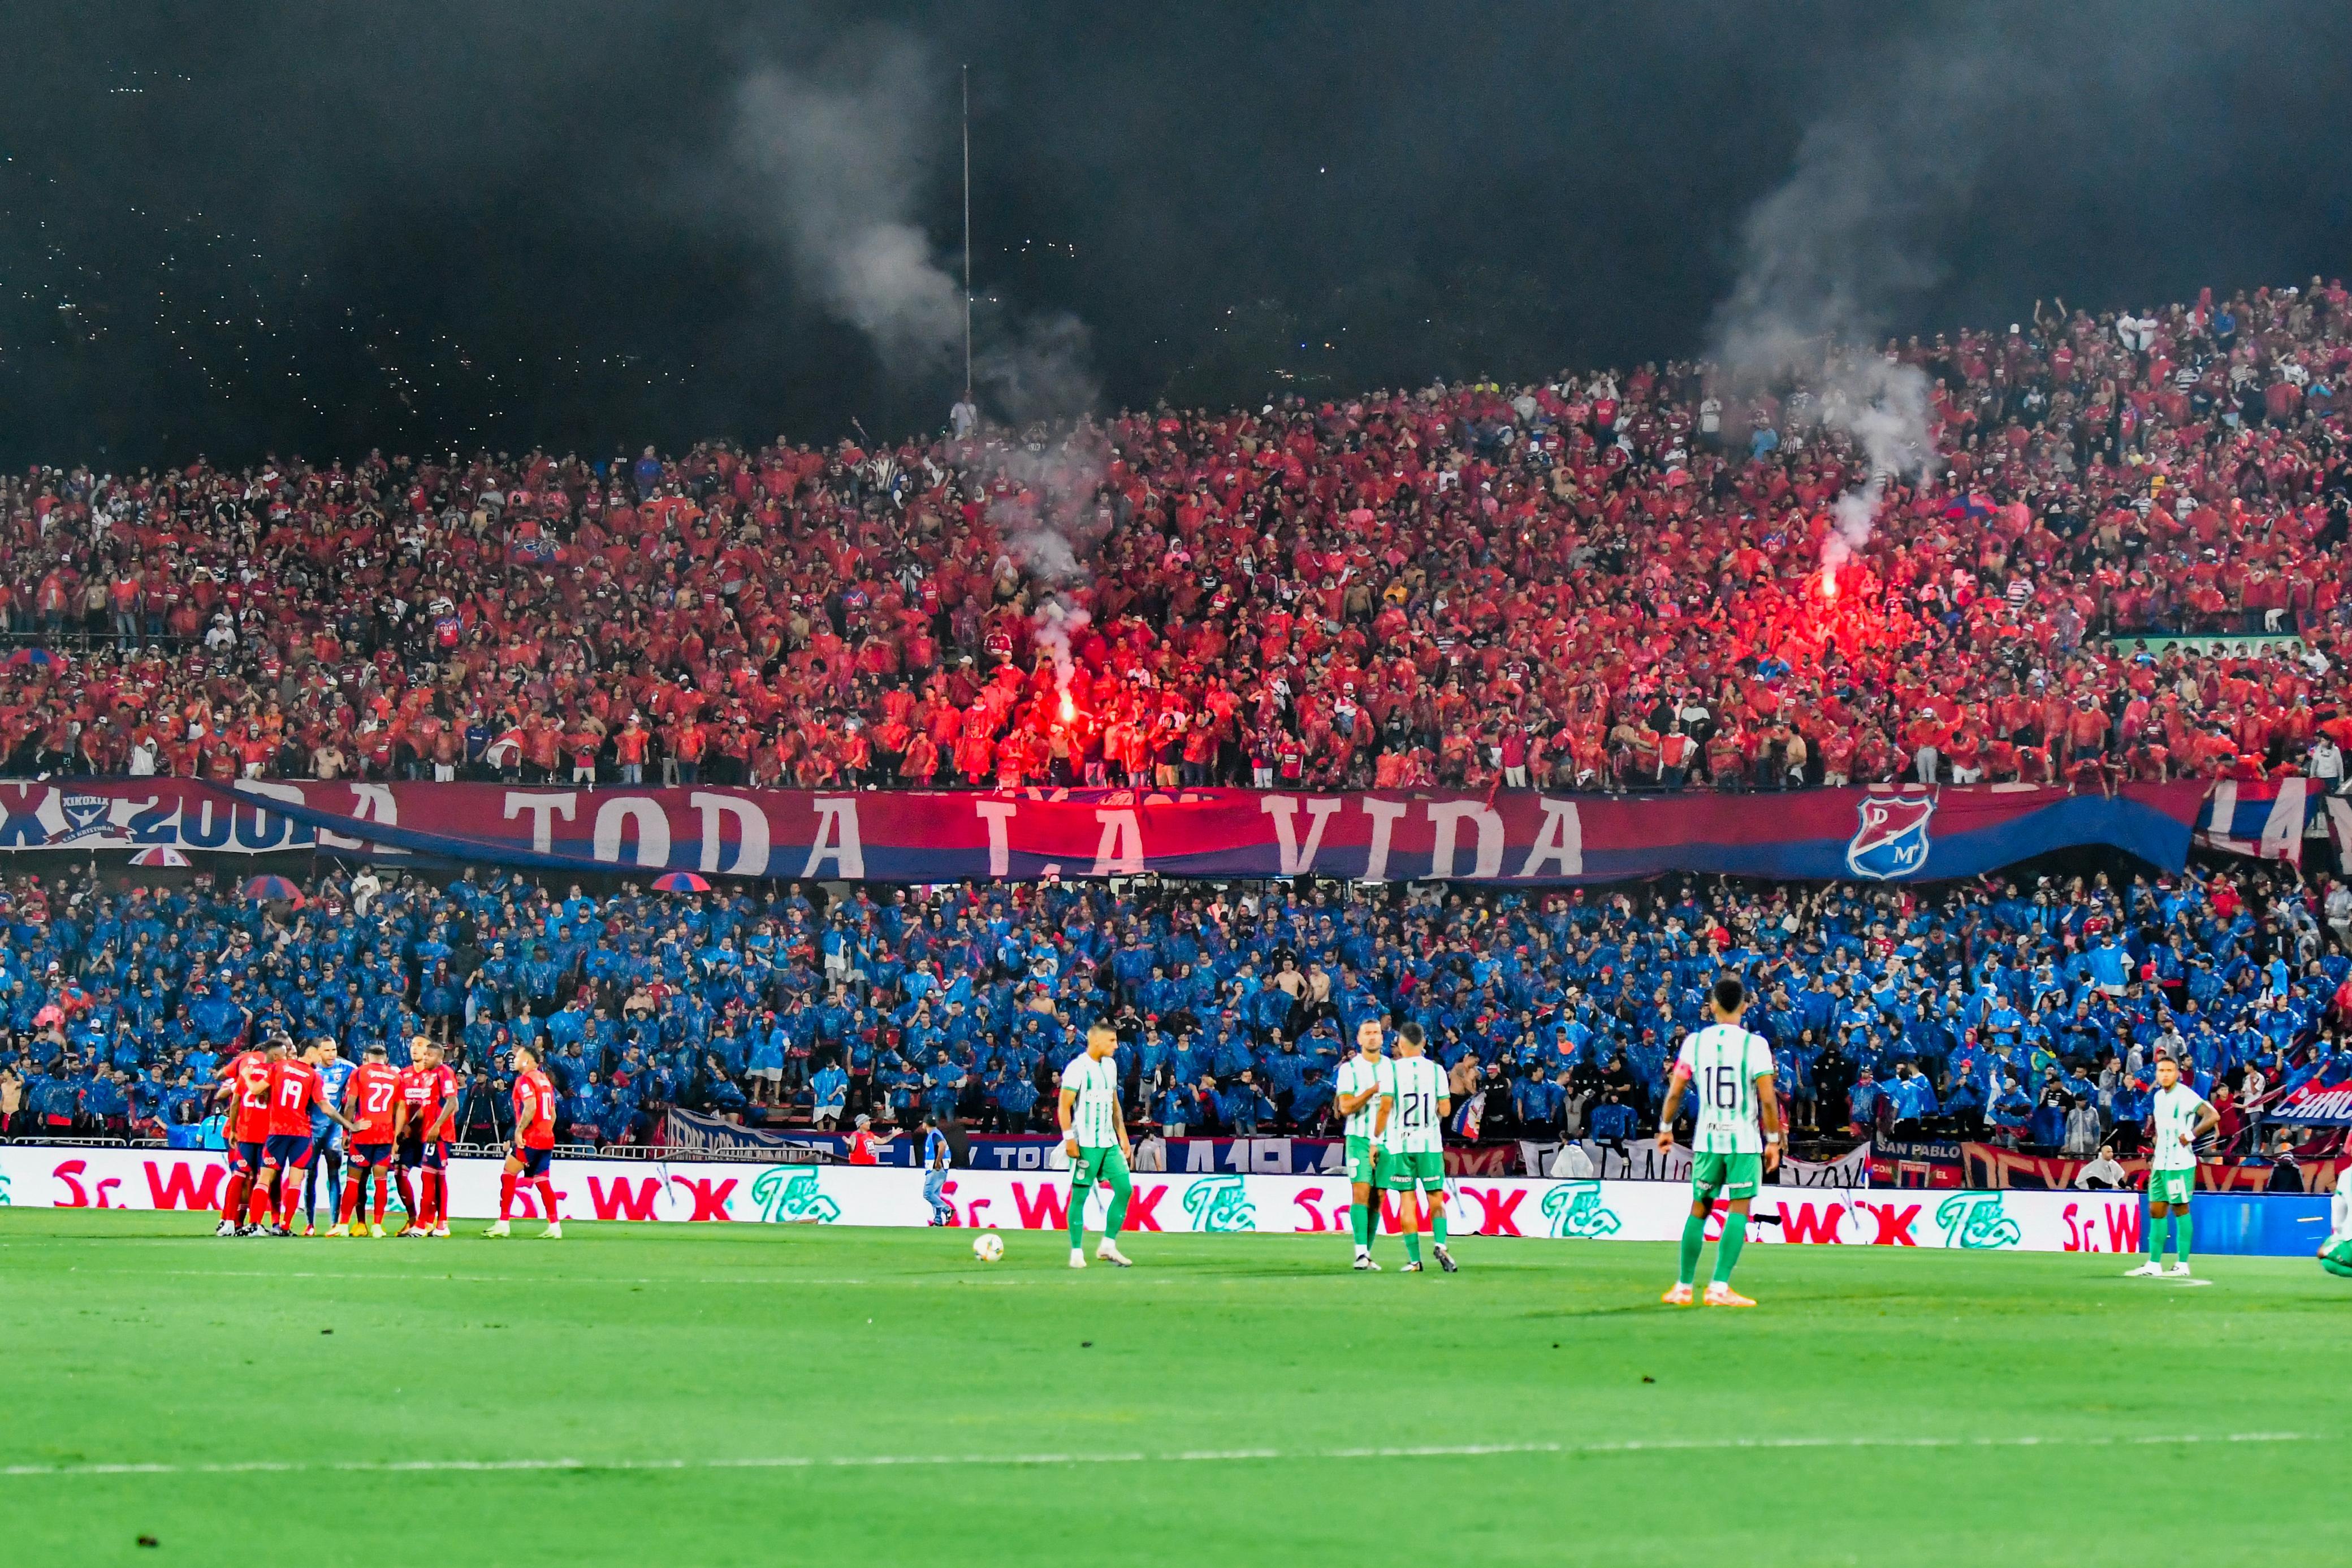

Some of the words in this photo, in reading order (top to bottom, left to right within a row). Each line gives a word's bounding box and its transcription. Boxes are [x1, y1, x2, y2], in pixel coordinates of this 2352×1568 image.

[504, 791, 864, 878] TODA
[975, 800, 1153, 877] LA
[1261, 794, 1583, 881] VIDA
[280, 1078, 303, 1110] 19
[368, 1082, 395, 1112] 27
[1705, 1065, 1737, 1109] 16
[1403, 1093, 1430, 1128] 21
[1877, 1142, 1908, 1154] SAN
[1911, 1143, 1961, 1158] PABLO
[1872, 1163, 1892, 1174] CON
[1935, 1169, 1948, 1180] EL
[2063, 1203, 2099, 1253] Sr.
